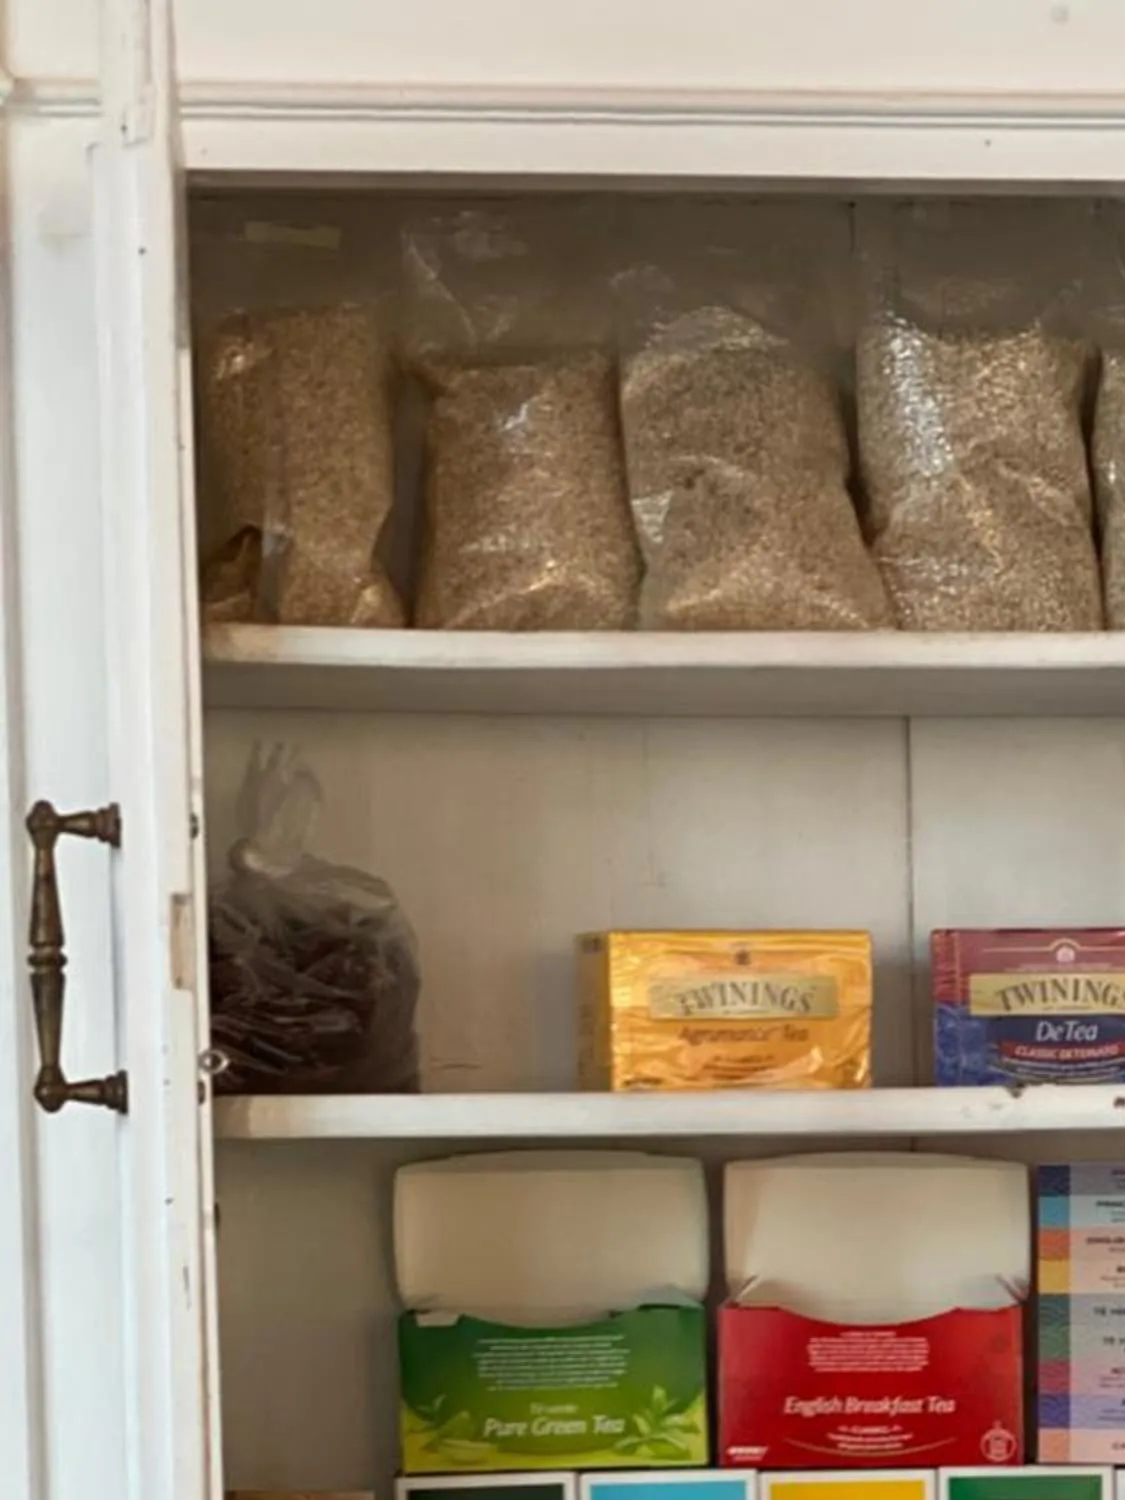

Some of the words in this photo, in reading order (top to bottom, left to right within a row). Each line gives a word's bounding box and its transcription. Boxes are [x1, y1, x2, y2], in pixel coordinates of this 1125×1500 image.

[675, 981, 814, 1015] TWININGS
[783, 1396, 842, 1418] English
[846, 1395, 923, 1416] Breakfast
[927, 1396, 956, 1413] Tea
[484, 1417, 527, 1437] Pure
[531, 1415, 587, 1437] Green
[593, 1415, 625, 1433] Tea
